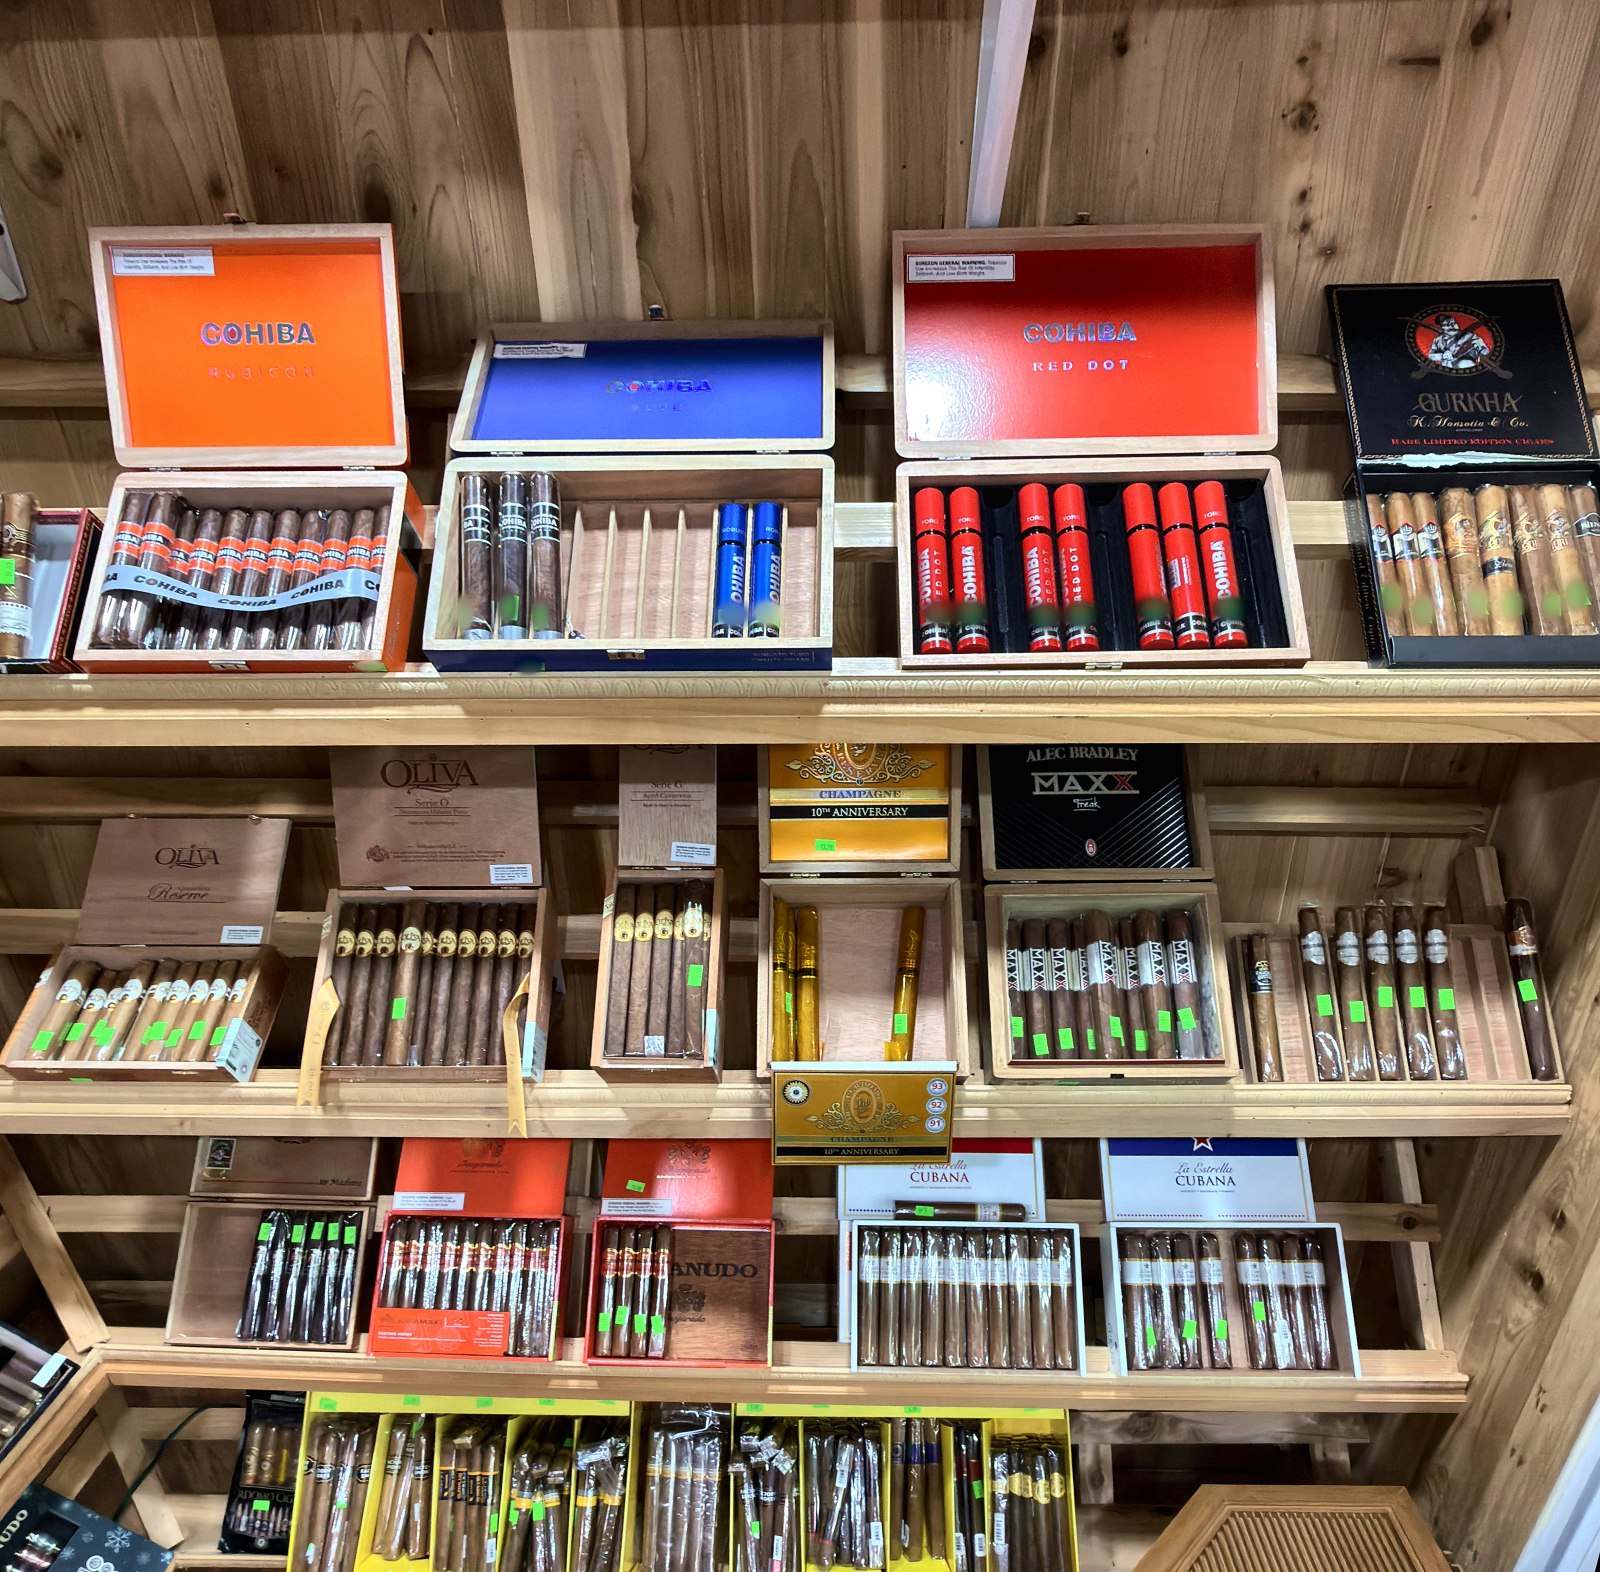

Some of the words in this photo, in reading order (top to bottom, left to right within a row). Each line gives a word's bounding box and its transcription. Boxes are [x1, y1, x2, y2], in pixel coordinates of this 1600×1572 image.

[200, 321, 316, 347] COHIBA
[1022, 321, 1137, 344] COHIBA
[1032, 360, 1073, 372] RED
[1087, 359, 1129, 371] DOT
[605, 379, 712, 393] COHIBA
[1412, 391, 1523, 413] GURKHA
[1069, 547, 1080, 572] DOT
[1210, 541, 1232, 600] COHIBA
[731, 555, 745, 604] OHIBA
[769, 554, 781, 604] OHIBA
[1026, 546, 1042, 607] COHIBA
[134, 575, 198, 599] COHIBA
[218, 598, 277, 607] COHIBA
[291, 579, 345, 599] COHIBA
[1072, 576, 1082, 602] RED
[1026, 747, 1067, 763] ALEC
[1069, 746, 1139, 761] BRADLEY
[380, 756, 480, 793] OLIVA
[1031, 771, 1140, 795] MAXX
[415, 799, 438, 807] Serie
[440, 798, 449, 807] O
[820, 790, 901, 799] CHAMPAGNE
[1073, 797, 1100, 809] Freak
[811, 808, 830, 817] 10TH
[832, 807, 908, 817] ANNIVERSARY
[155, 844, 220, 868] OLIVA
[1007, 948, 1020, 991] MAXX
[1030, 948, 1047, 991] MAXX
[1051, 947, 1069, 991] MAXX
[1099, 940, 1116, 982] MAXX
[1149, 941, 1167, 985] MAXX
[1172, 940, 1194, 984] MAXX
[931, 1082, 943, 1090] 93
[931, 1101, 942, 1109] 92
[910, 1171, 970, 1183] CUBANA
[1175, 1162, 1190, 1174] La
[1194, 1162, 1233, 1173] Estrella
[1175, 1175, 1236, 1186] CUBANA
[671, 1263, 758, 1278] ANUDO
